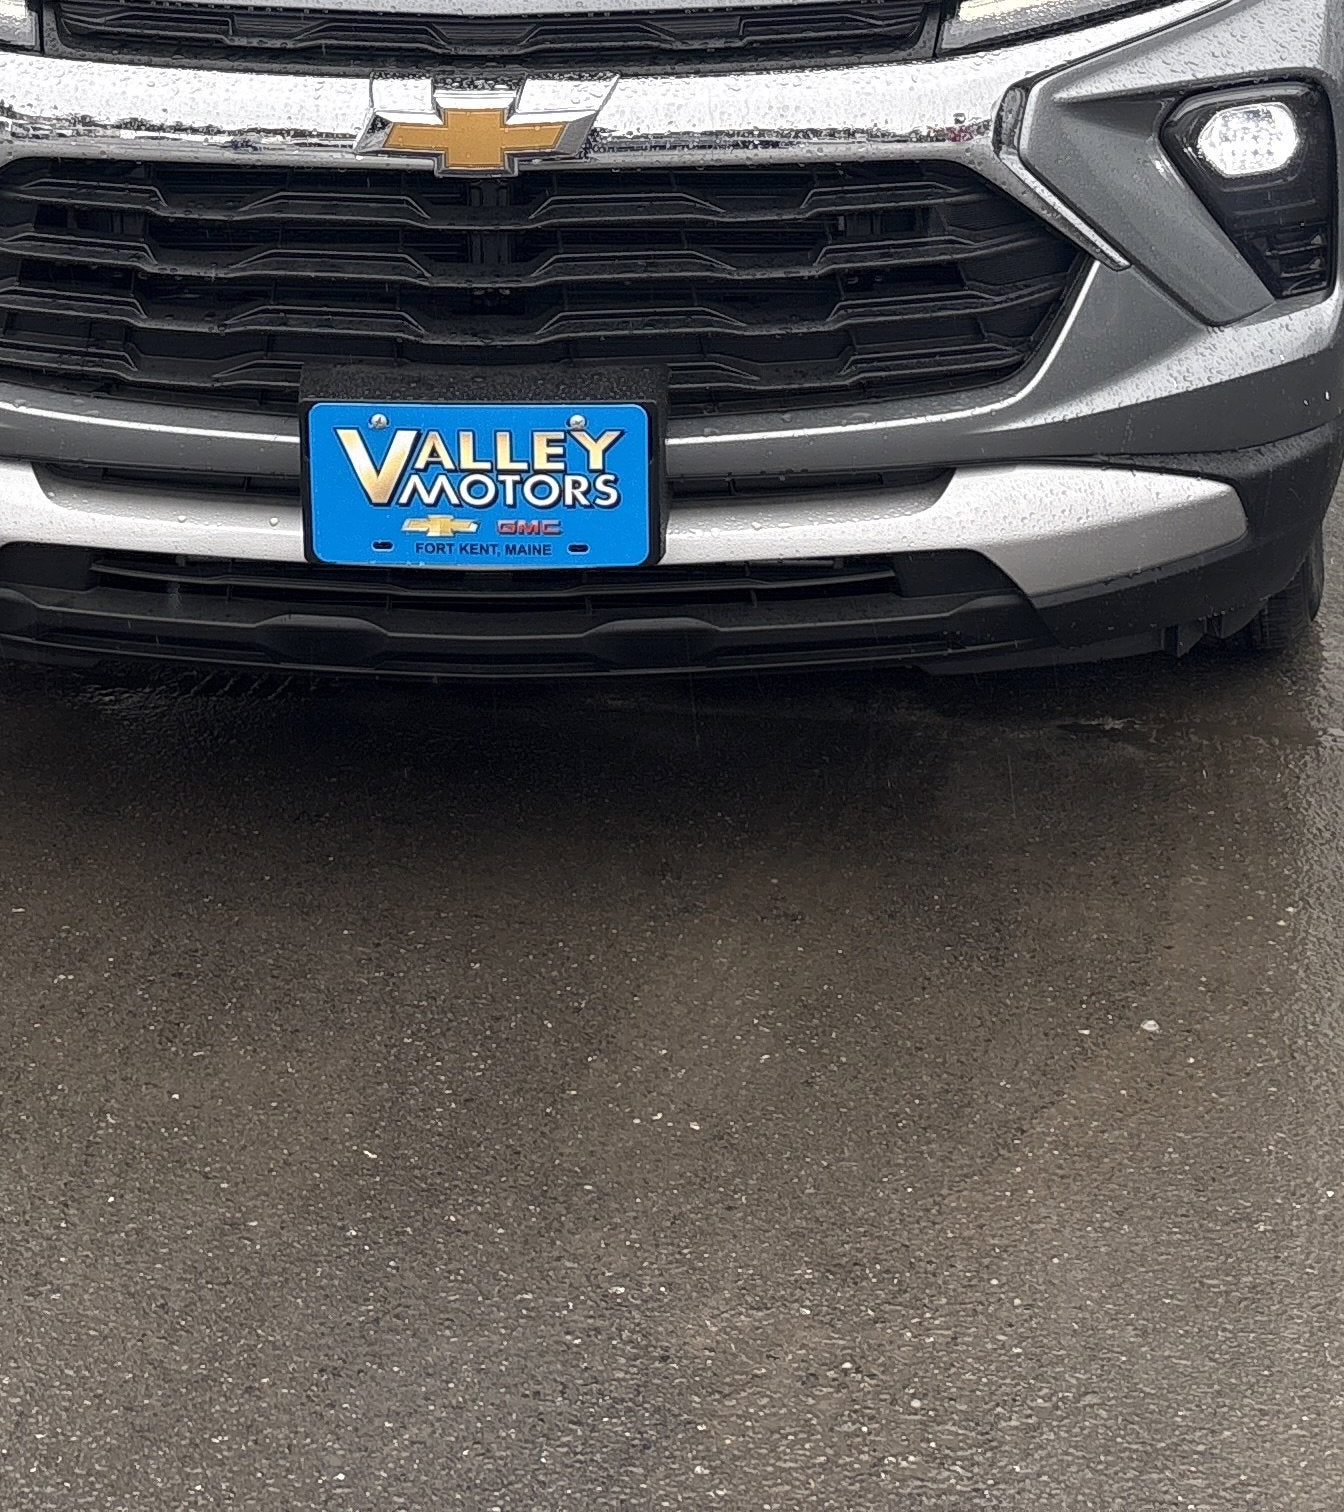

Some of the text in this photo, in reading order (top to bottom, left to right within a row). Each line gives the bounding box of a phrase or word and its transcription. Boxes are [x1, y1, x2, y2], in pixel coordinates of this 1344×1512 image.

[334, 426, 625, 506] VALLEY
[398, 472, 623, 509] MOTORS
[497, 519, 561, 535] GMC
[415, 542, 552, 557] FORT KENT, MAINE
